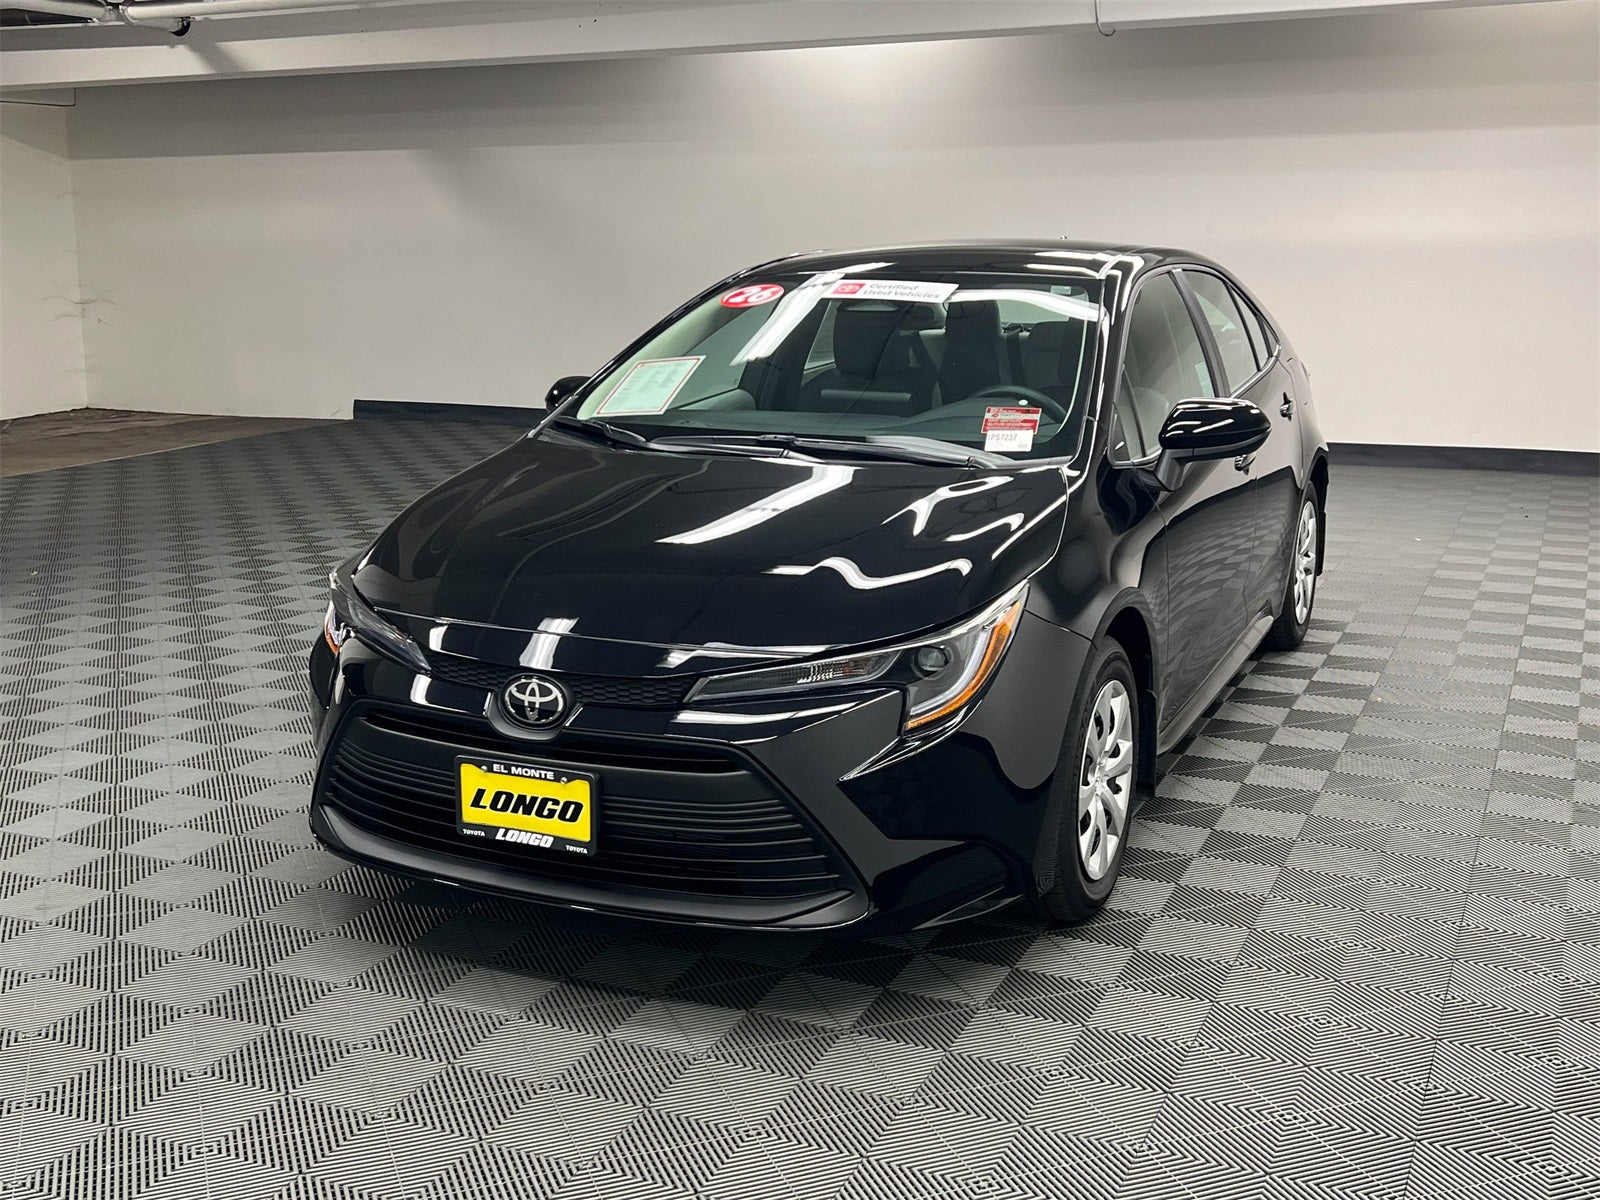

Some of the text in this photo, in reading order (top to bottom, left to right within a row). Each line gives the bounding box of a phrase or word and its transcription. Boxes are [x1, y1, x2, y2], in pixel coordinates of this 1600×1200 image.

[869, 283, 920, 291] Certified
[727, 286, 780, 304] 26
[894, 290, 941, 300] Vehicles
[493, 764, 554, 780] EL MONTE
[470, 787, 584, 823] LONGO
[463, 829, 485, 837] TOYOTA
[495, 828, 554, 848] LONGO
[566, 845, 588, 854] TOYOTA
